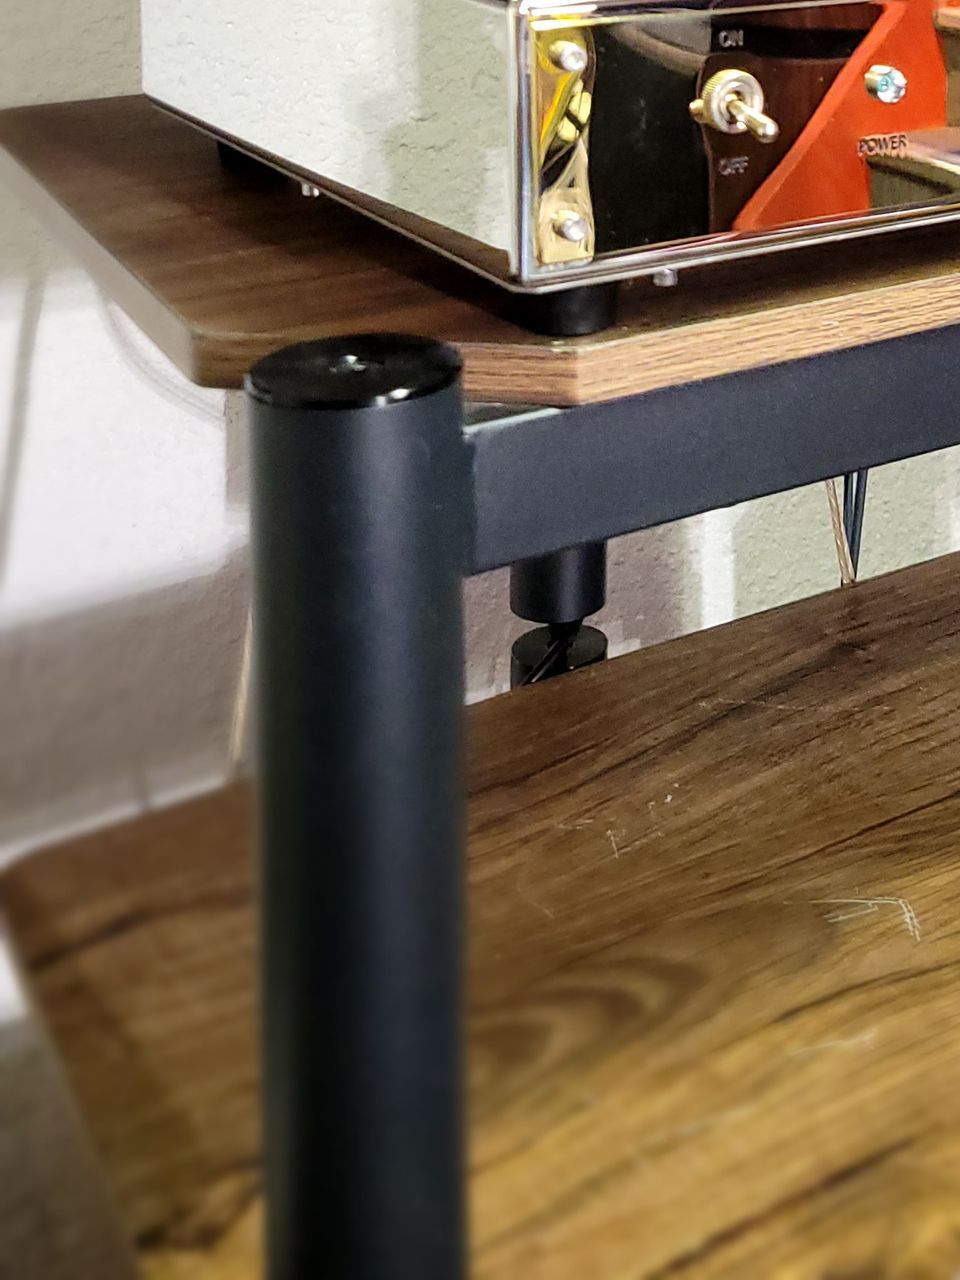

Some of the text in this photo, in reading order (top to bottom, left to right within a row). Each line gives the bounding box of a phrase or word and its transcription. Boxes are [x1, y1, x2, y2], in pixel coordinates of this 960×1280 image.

[719, 29, 744, 48] ON
[858, 133, 908, 155] POWER
[718, 155, 749, 176] OFF
